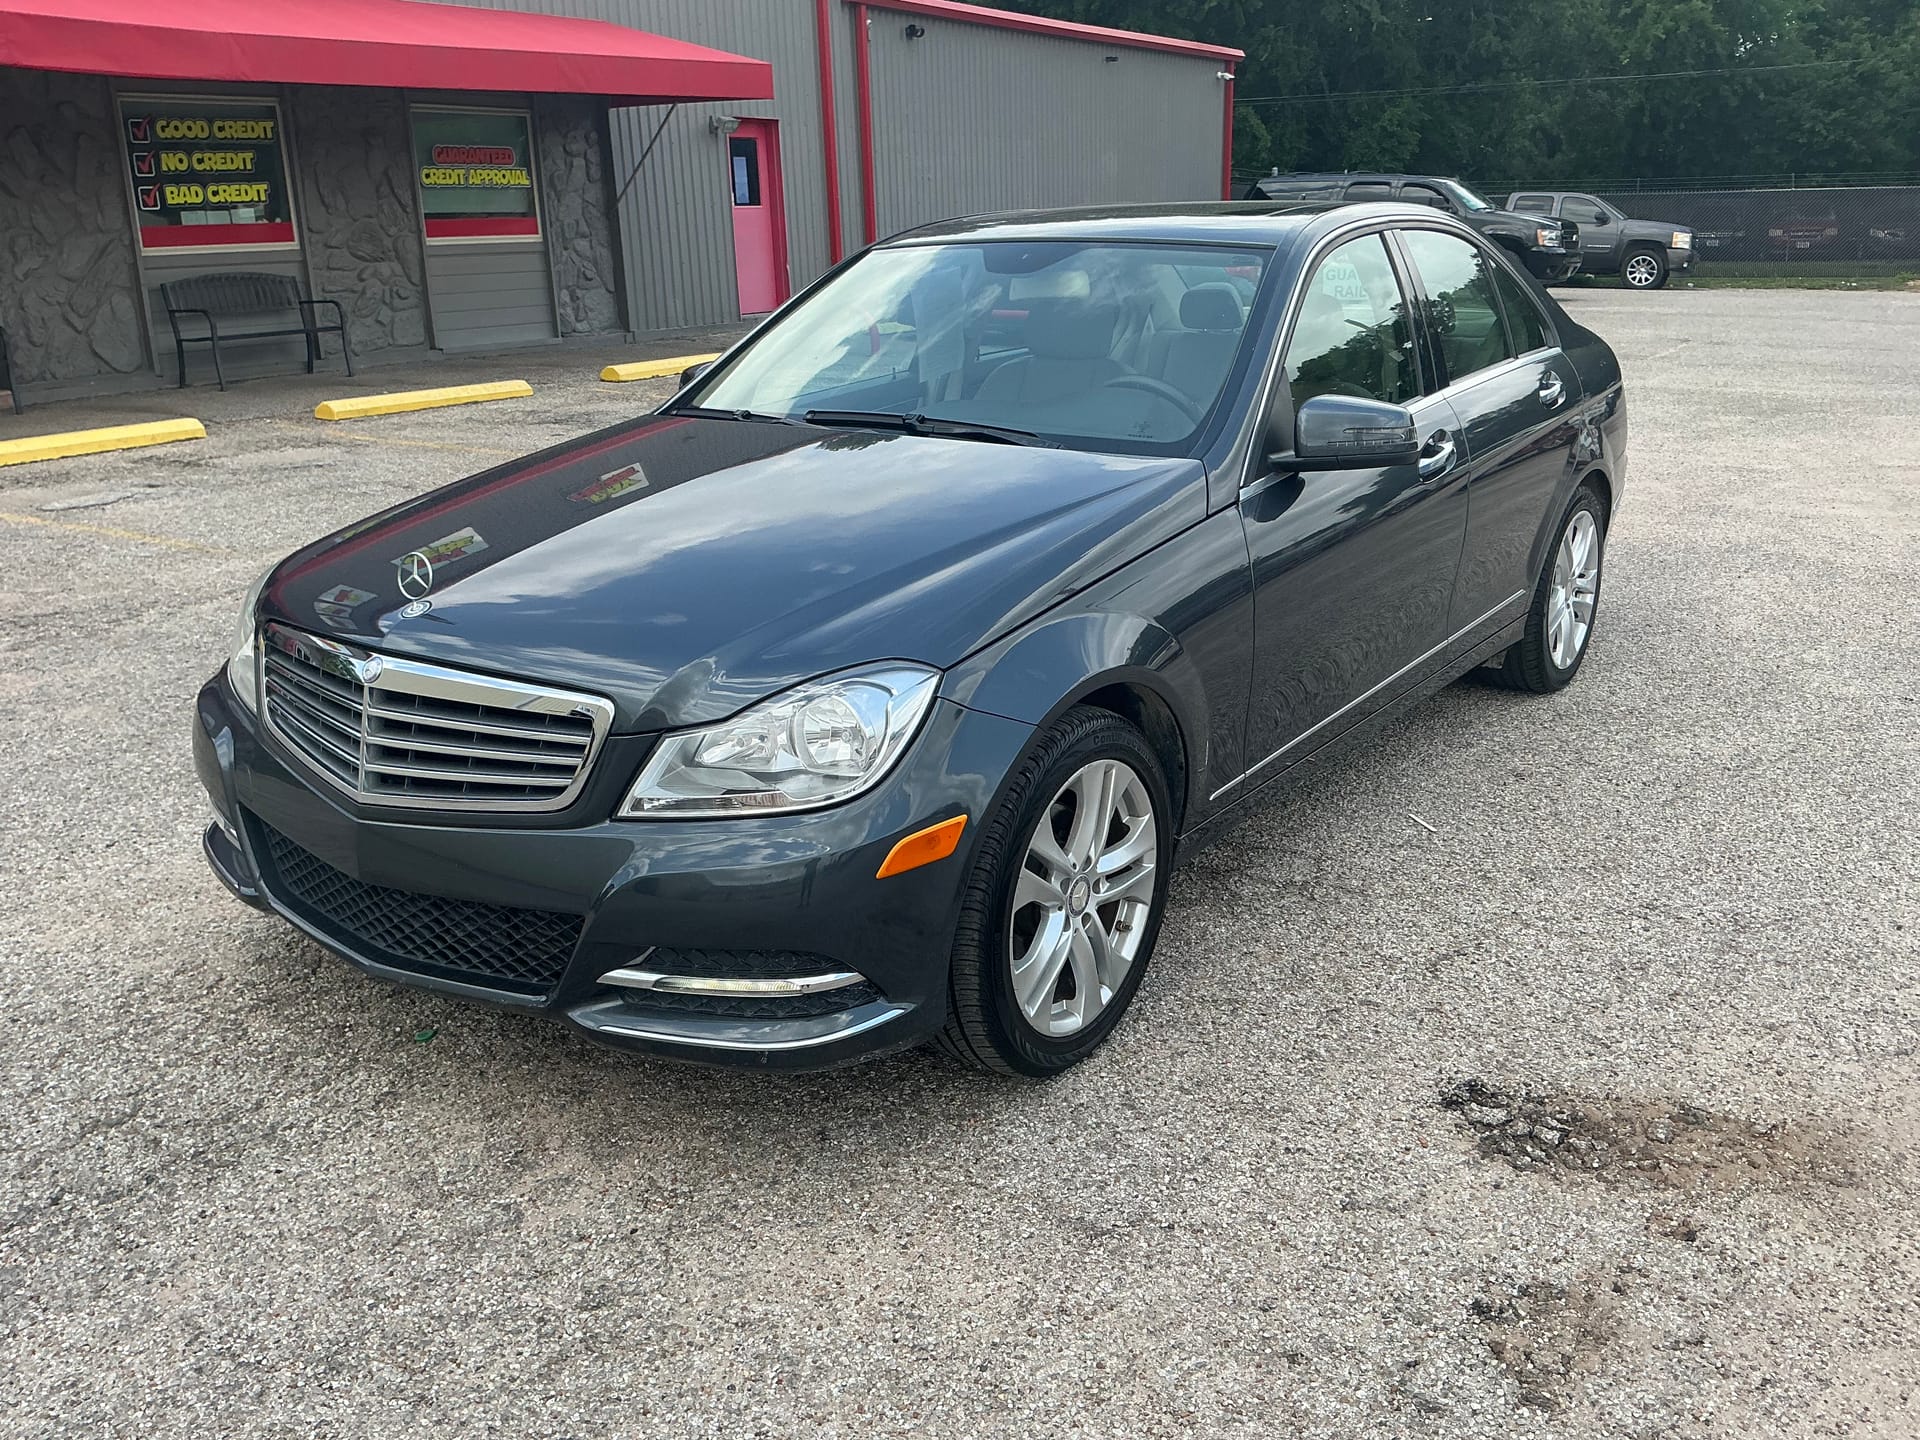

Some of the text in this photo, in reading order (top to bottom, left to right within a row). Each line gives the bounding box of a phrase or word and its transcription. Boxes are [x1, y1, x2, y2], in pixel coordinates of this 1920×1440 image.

[155, 118, 275, 141] GOOD CREDIT
[161, 151, 254, 173] NO CREDIT
[433, 146, 515, 166] GUARANTEED
[422, 167, 530, 187] CREDIT APPROVAL
[164, 183, 269, 205] BAD CREDIT
